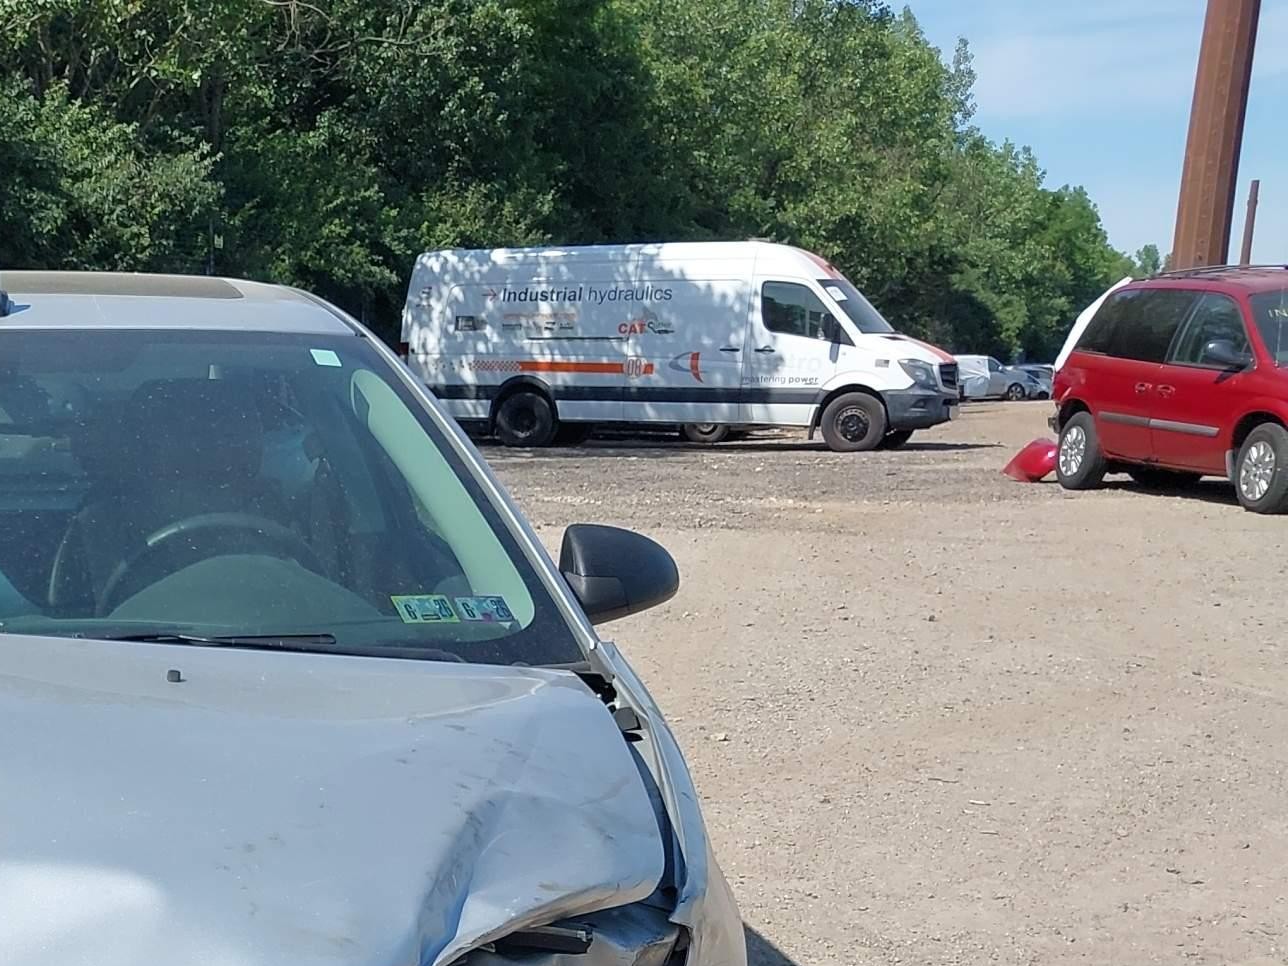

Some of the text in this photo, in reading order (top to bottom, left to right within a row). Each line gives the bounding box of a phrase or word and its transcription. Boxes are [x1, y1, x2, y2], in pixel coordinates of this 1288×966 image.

[502, 285, 673, 304] Industrial hydraulics
[618, 321, 646, 334] CAT
[788, 376, 819, 385] power
